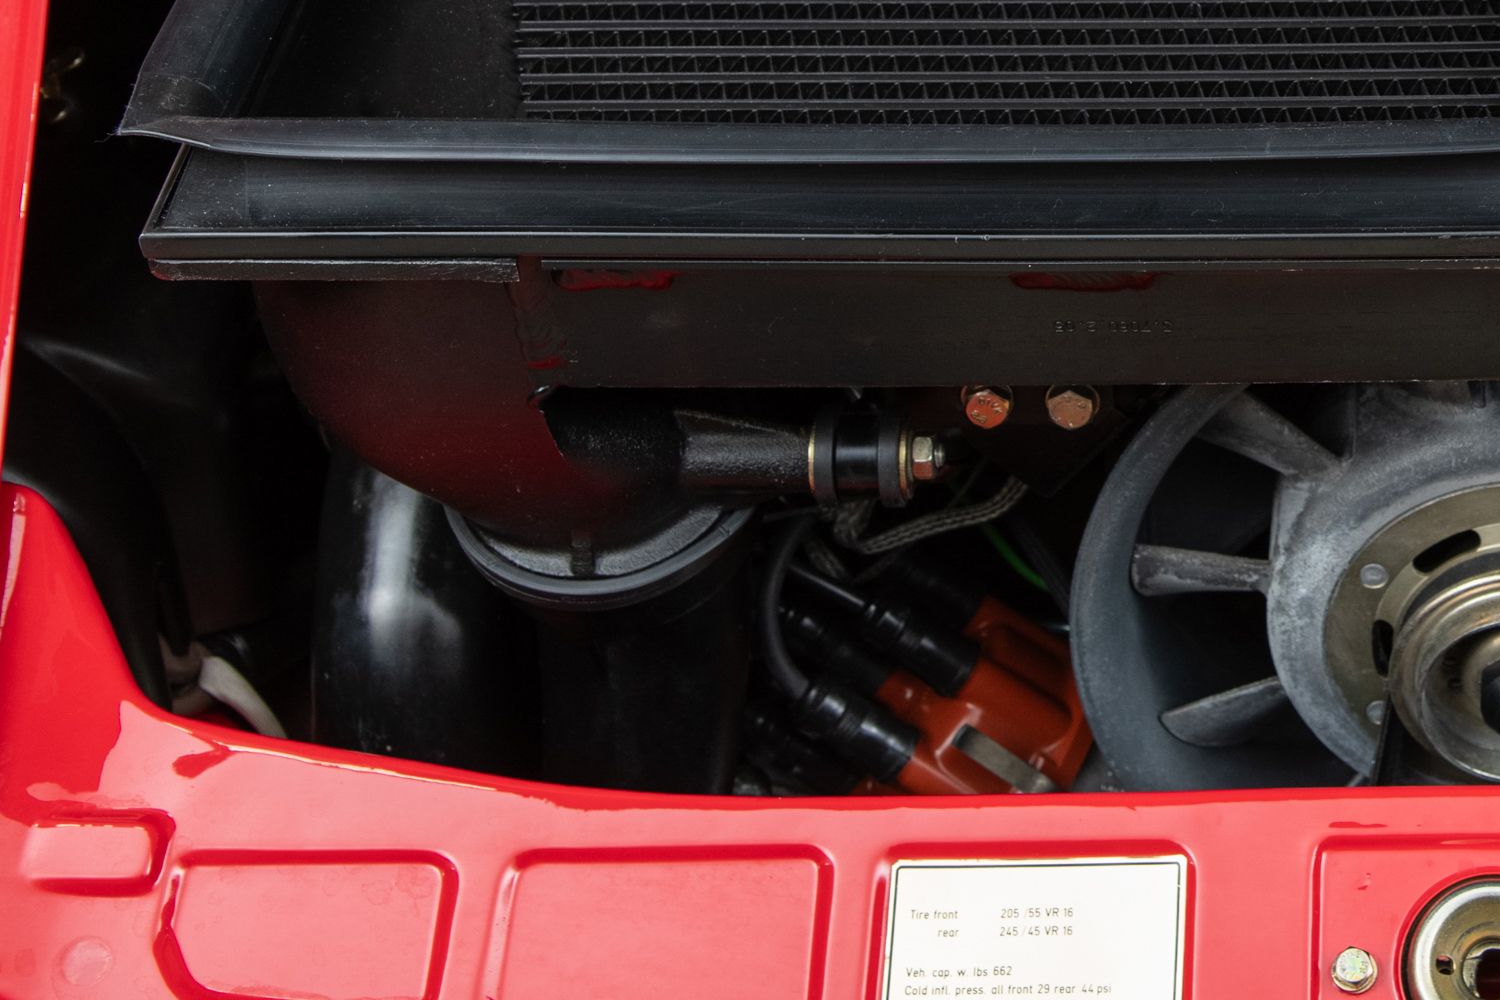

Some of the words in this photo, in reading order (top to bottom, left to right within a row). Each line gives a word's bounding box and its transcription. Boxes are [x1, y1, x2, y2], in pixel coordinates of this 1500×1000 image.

[911, 910, 929, 920] Tire
[934, 909, 958, 920] front
[1000, 908, 1019, 918] 205
[1045, 908, 1059, 918] VR
[1064, 907, 1074, 917] 16
[938, 928, 959, 938] rear
[1000, 926, 1019, 937] 245
[1045, 926, 1058, 935] VR
[1063, 926, 1073, 935] 16
[973, 966, 988, 977] lbs
[993, 966, 1012, 976] 662
[904, 986, 927, 996] Cold
[991, 985, 1004, 995] all
[1008, 984, 1033, 994] front
[1038, 984, 1050, 994] 29
[1054, 985, 1075, 993] rear
[1082, 984, 1094, 993] 44
[1097, 985, 1112, 995] psi
